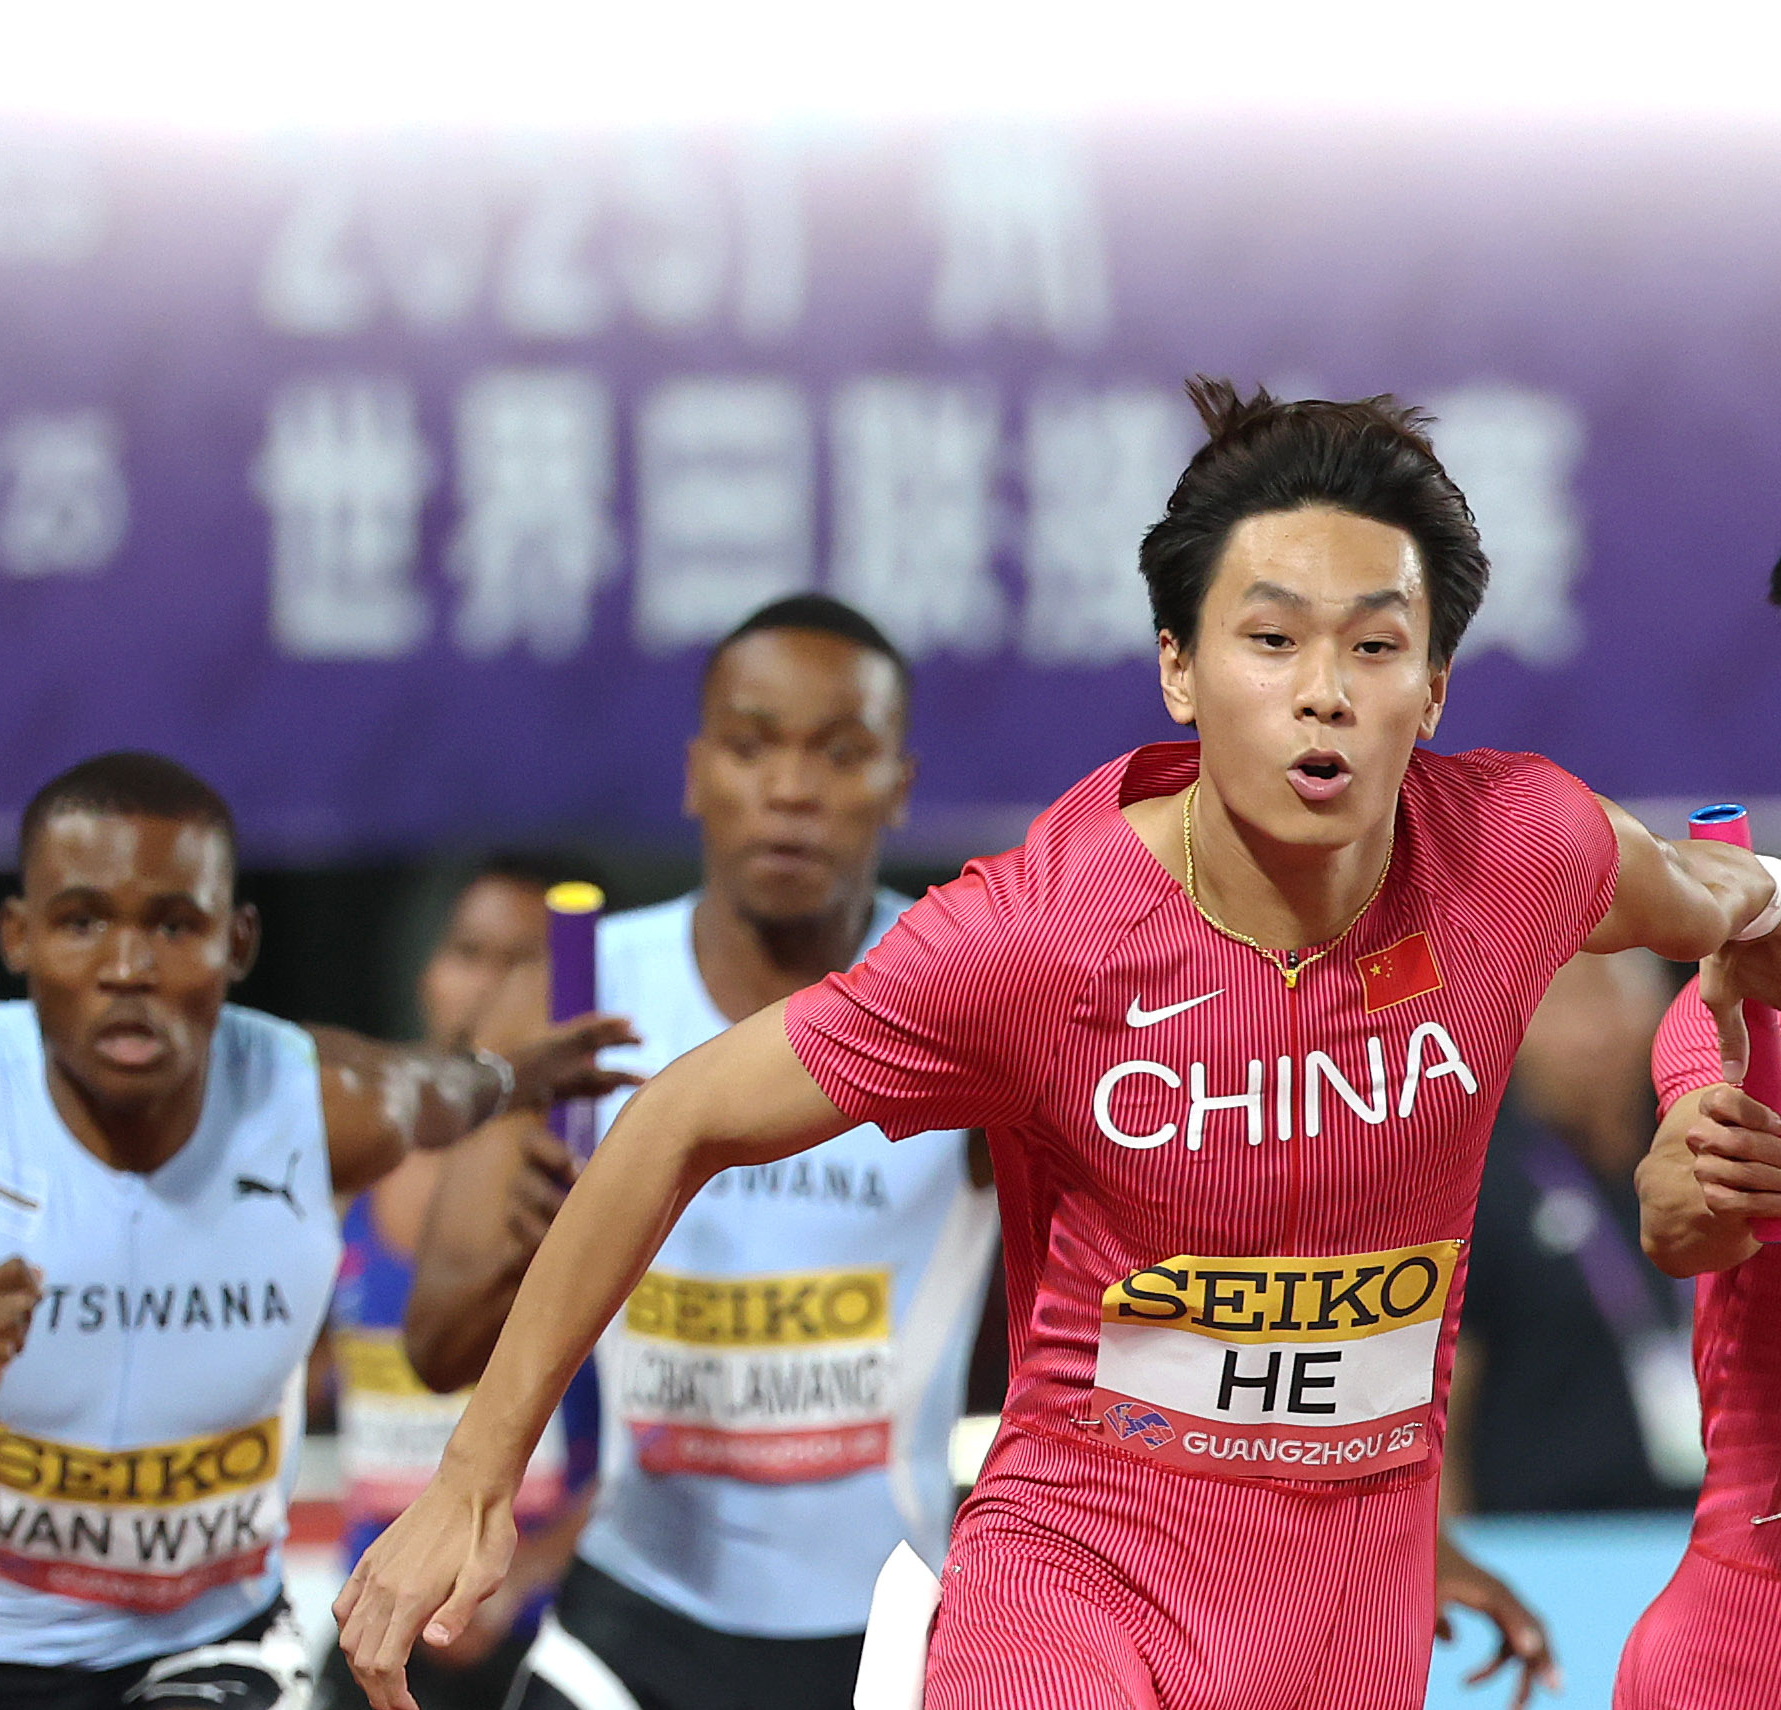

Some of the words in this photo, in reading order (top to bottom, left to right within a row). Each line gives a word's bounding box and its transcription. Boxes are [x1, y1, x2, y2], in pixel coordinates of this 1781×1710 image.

[1093, 1020, 1478, 1152] CHINA
[44, 1278, 291, 1334] TSWANA
[625, 1276, 882, 1342] SEIKO
[1118, 1255, 1439, 1333] SEIKO
[1215, 1348, 1343, 1416] HE
[1181, 1429, 1382, 1466] GUANGZHOU
[1385, 1424, 1417, 1451] 25
[133, 1492, 264, 1562] WYK
